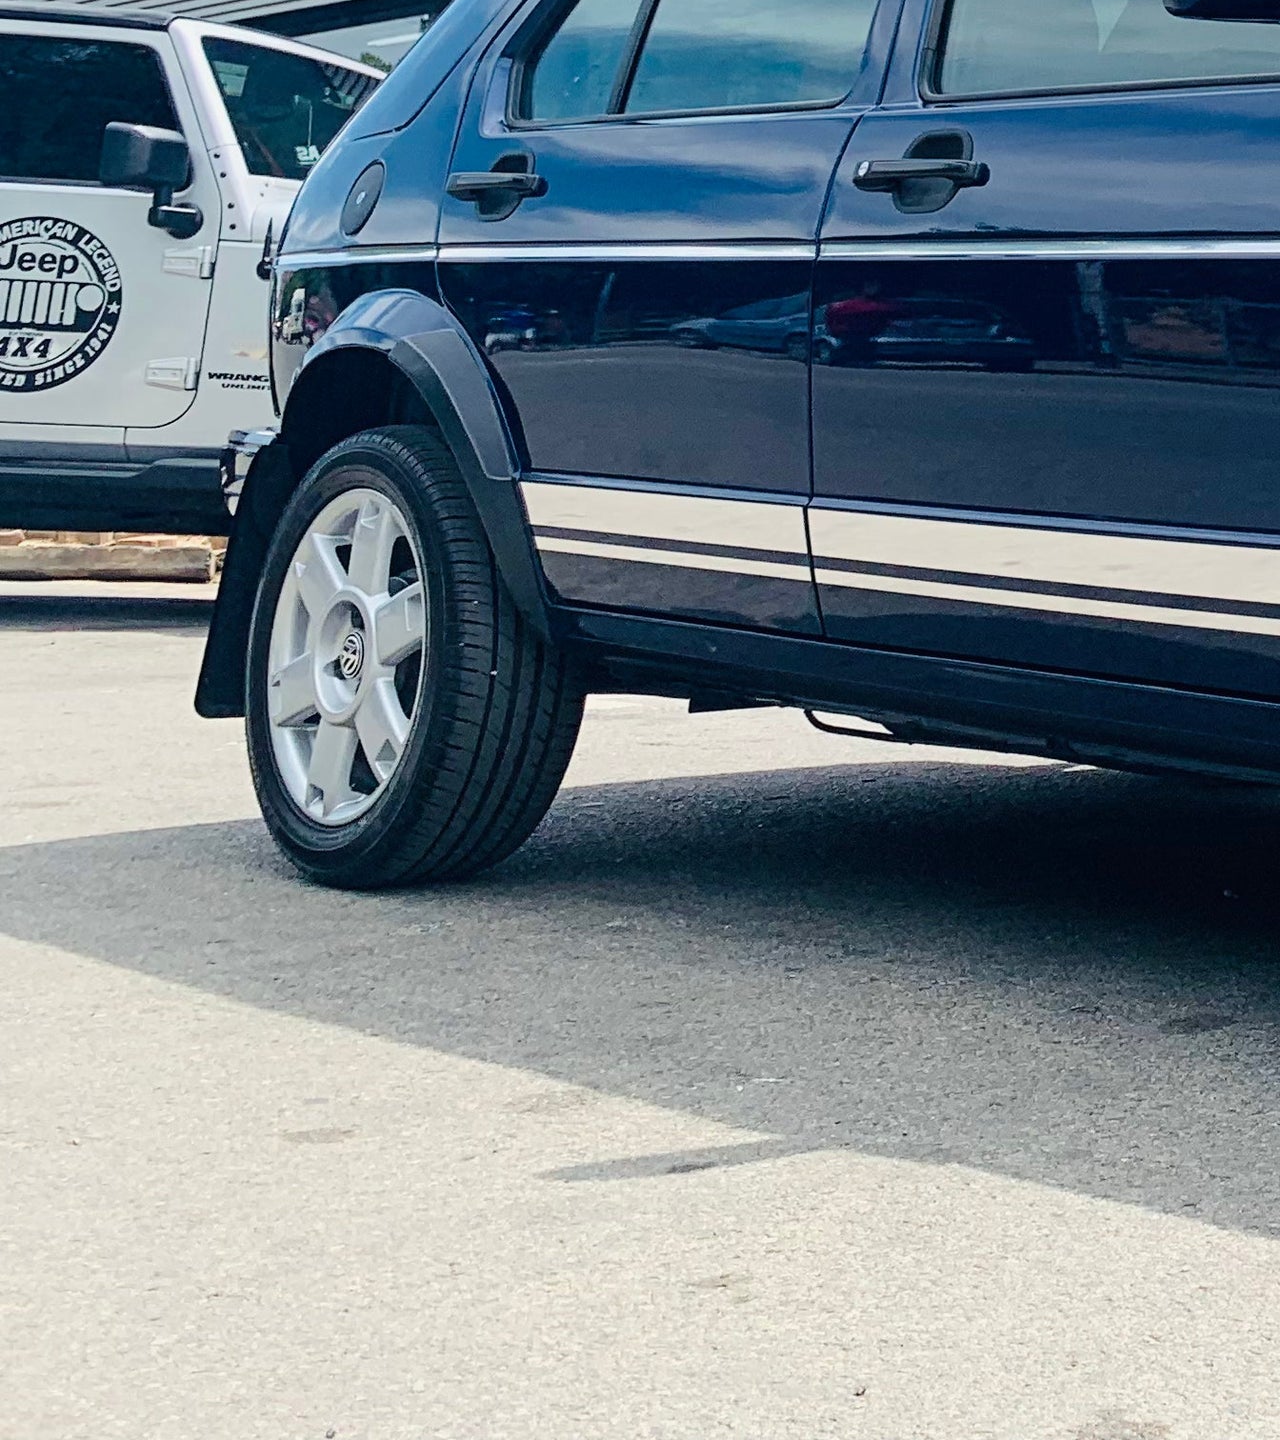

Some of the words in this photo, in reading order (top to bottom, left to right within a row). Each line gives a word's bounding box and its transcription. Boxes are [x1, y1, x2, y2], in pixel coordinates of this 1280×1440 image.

[0, 244, 80, 279] Jeep
[77, 233, 122, 293] LEGEND
[34, 352, 86, 387] SINCE
